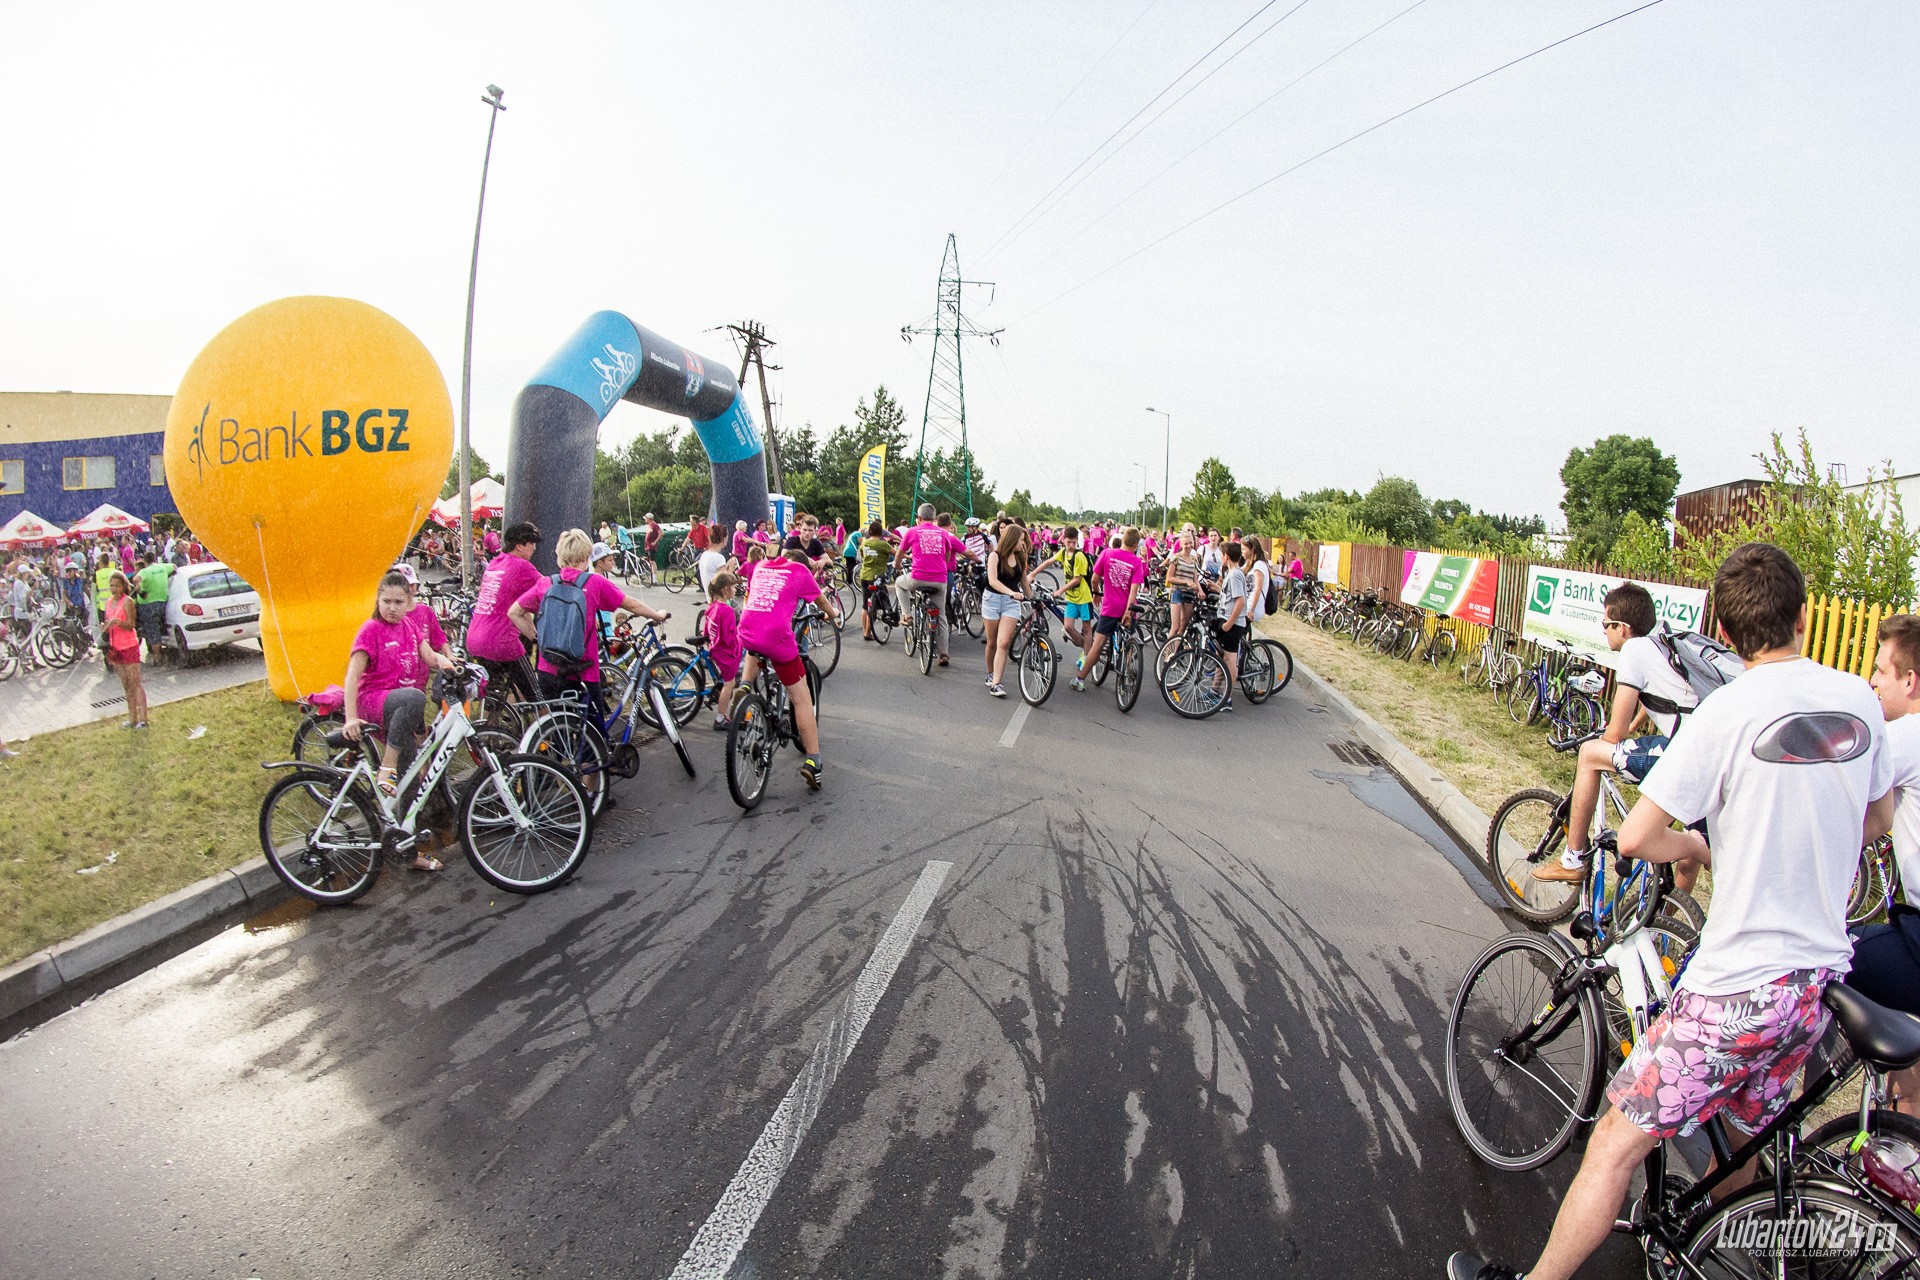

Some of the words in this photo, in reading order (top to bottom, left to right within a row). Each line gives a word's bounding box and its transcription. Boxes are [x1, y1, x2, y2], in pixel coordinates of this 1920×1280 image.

[220, 410, 313, 464] Bank
[1563, 578, 1594, 602] Bank
[1566, 609, 1598, 623] Lubartowie
